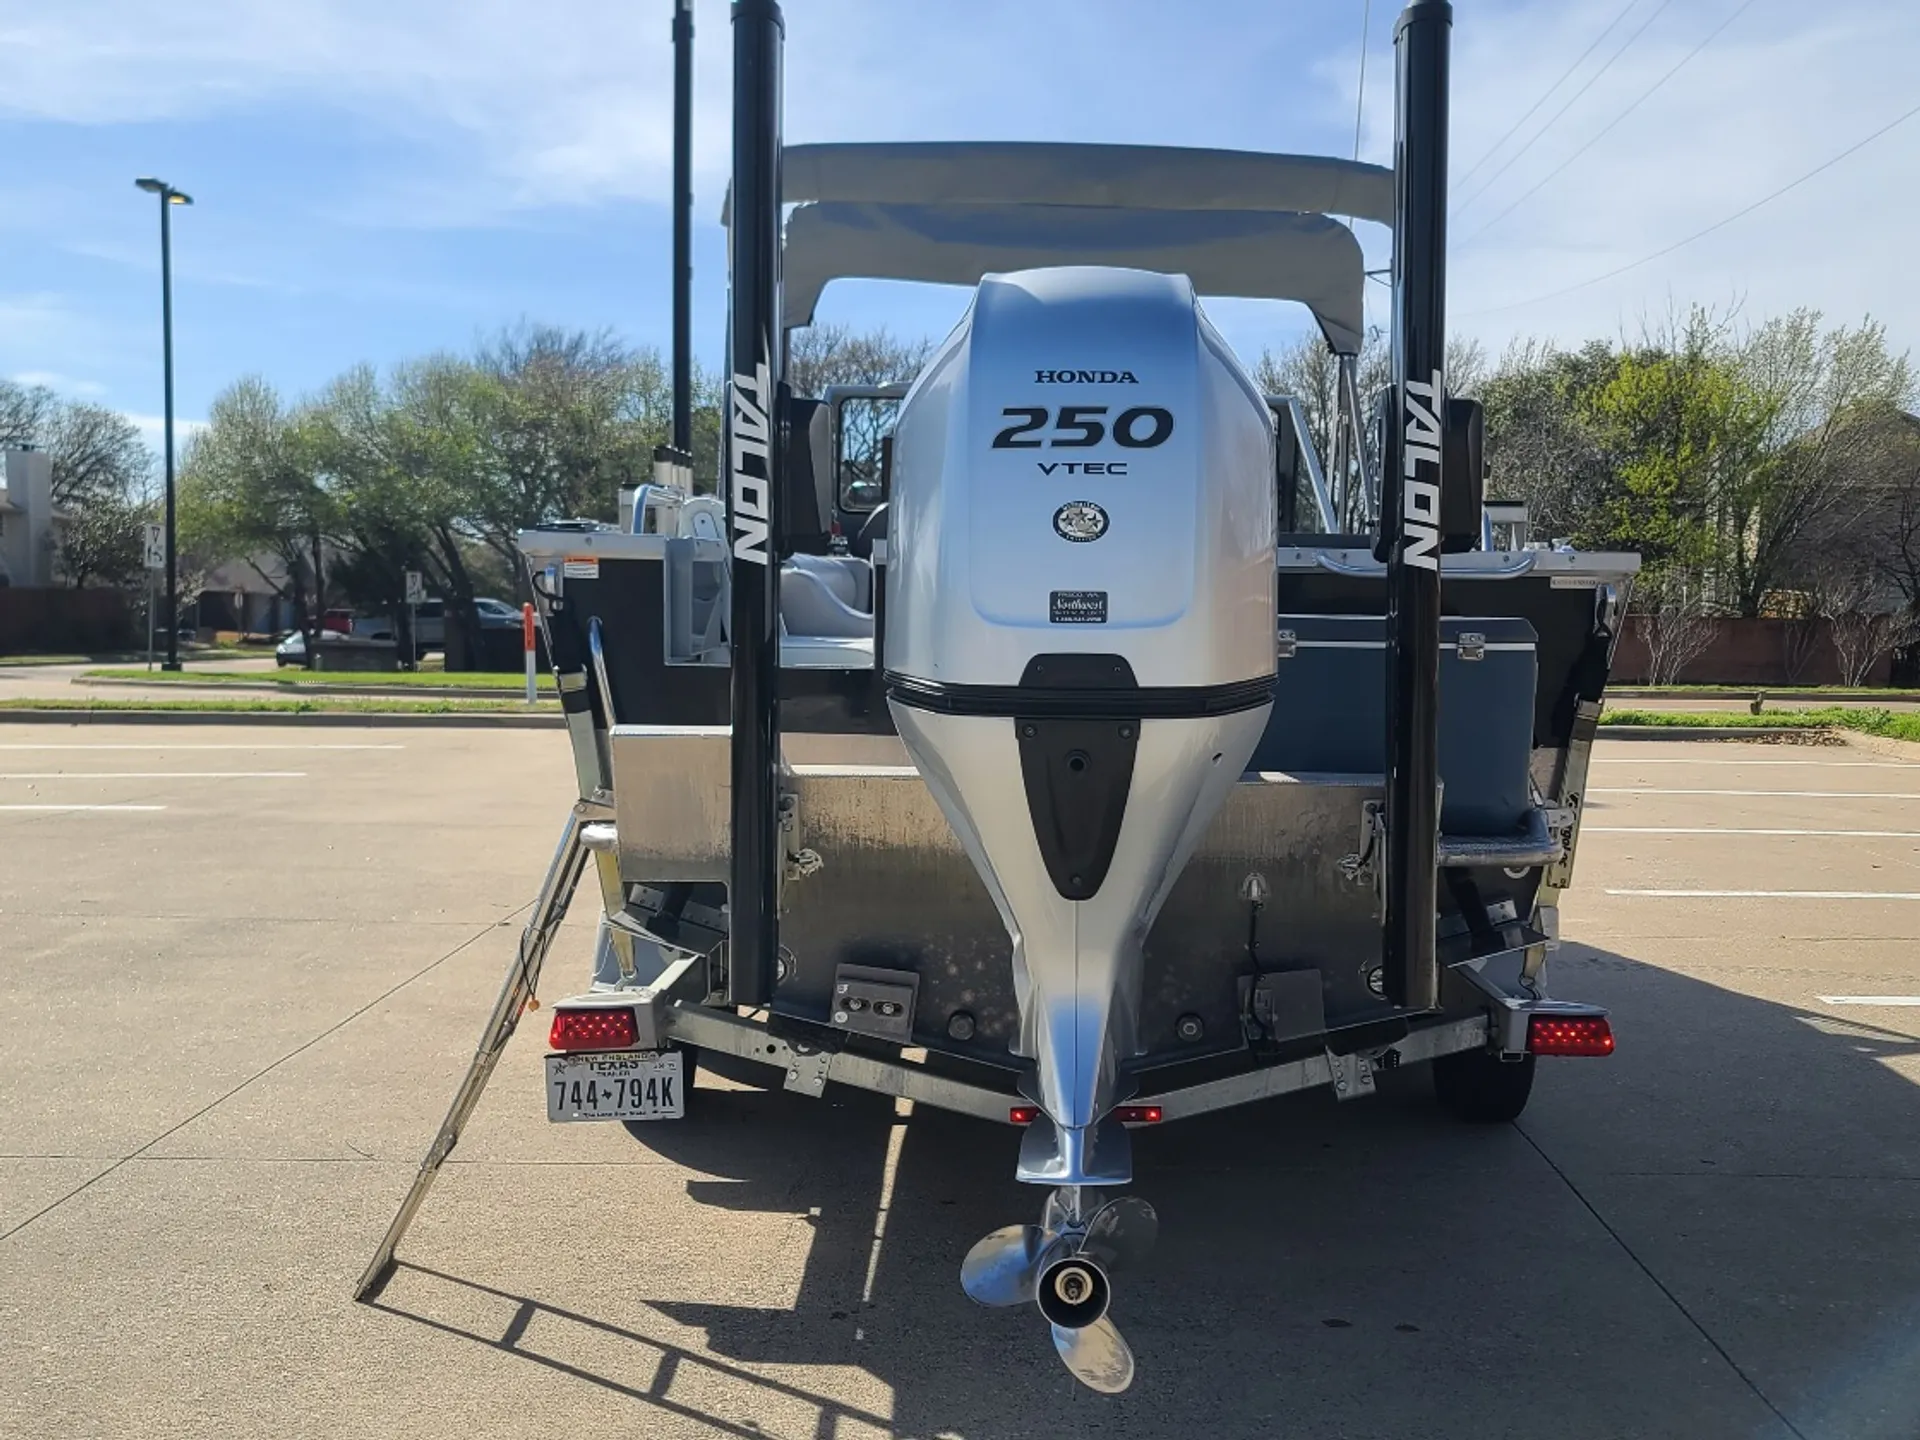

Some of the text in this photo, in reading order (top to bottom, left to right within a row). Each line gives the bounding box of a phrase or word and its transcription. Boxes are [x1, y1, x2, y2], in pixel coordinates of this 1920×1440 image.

[1034, 370, 1139, 384] HONDA
[991, 406, 1174, 449] 250
[734, 362, 769, 566] TALON
[1037, 462, 1128, 476] VTEC
[1403, 368, 1441, 572] TALON
[589, 1061, 639, 1071] TEXAS
[601, 1053, 648, 1062] ENGLAND
[554, 1077, 674, 1110] 744 794K
